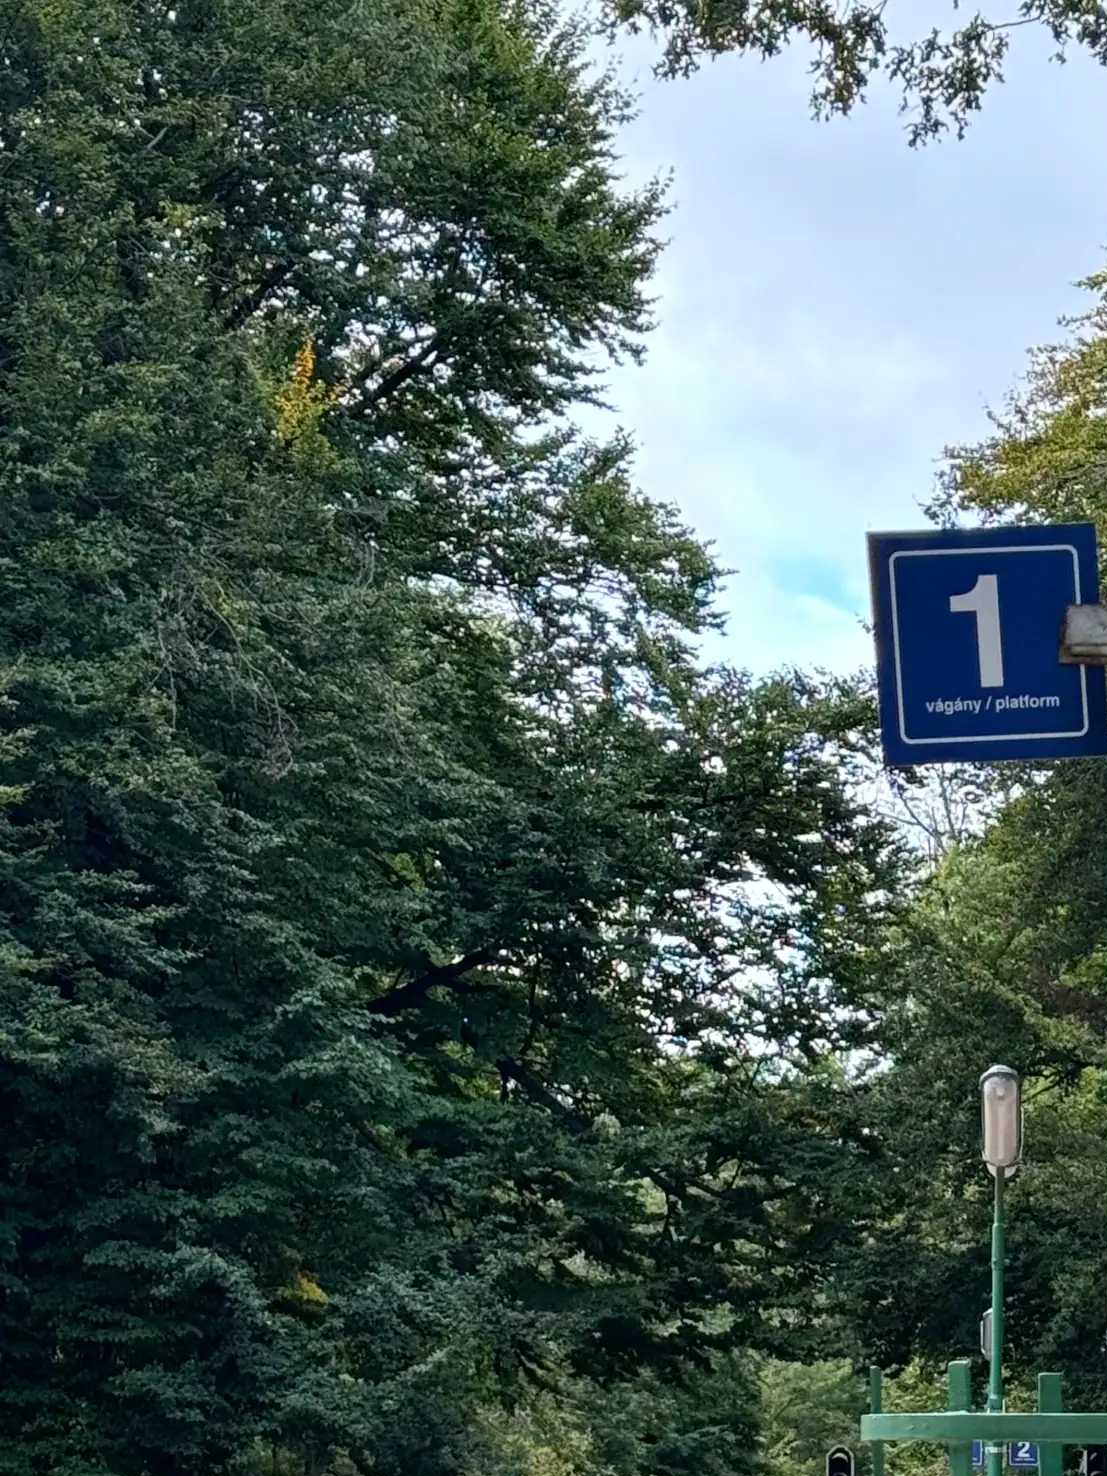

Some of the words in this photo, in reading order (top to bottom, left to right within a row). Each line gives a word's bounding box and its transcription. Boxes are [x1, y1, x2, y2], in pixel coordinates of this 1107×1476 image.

[949, 574, 1004, 688] 1
[926, 697, 981, 715] vágány
[985, 695, 993, 710] /
[995, 694, 1060, 712] platform
[1017, 1441, 1031, 1458] 2
